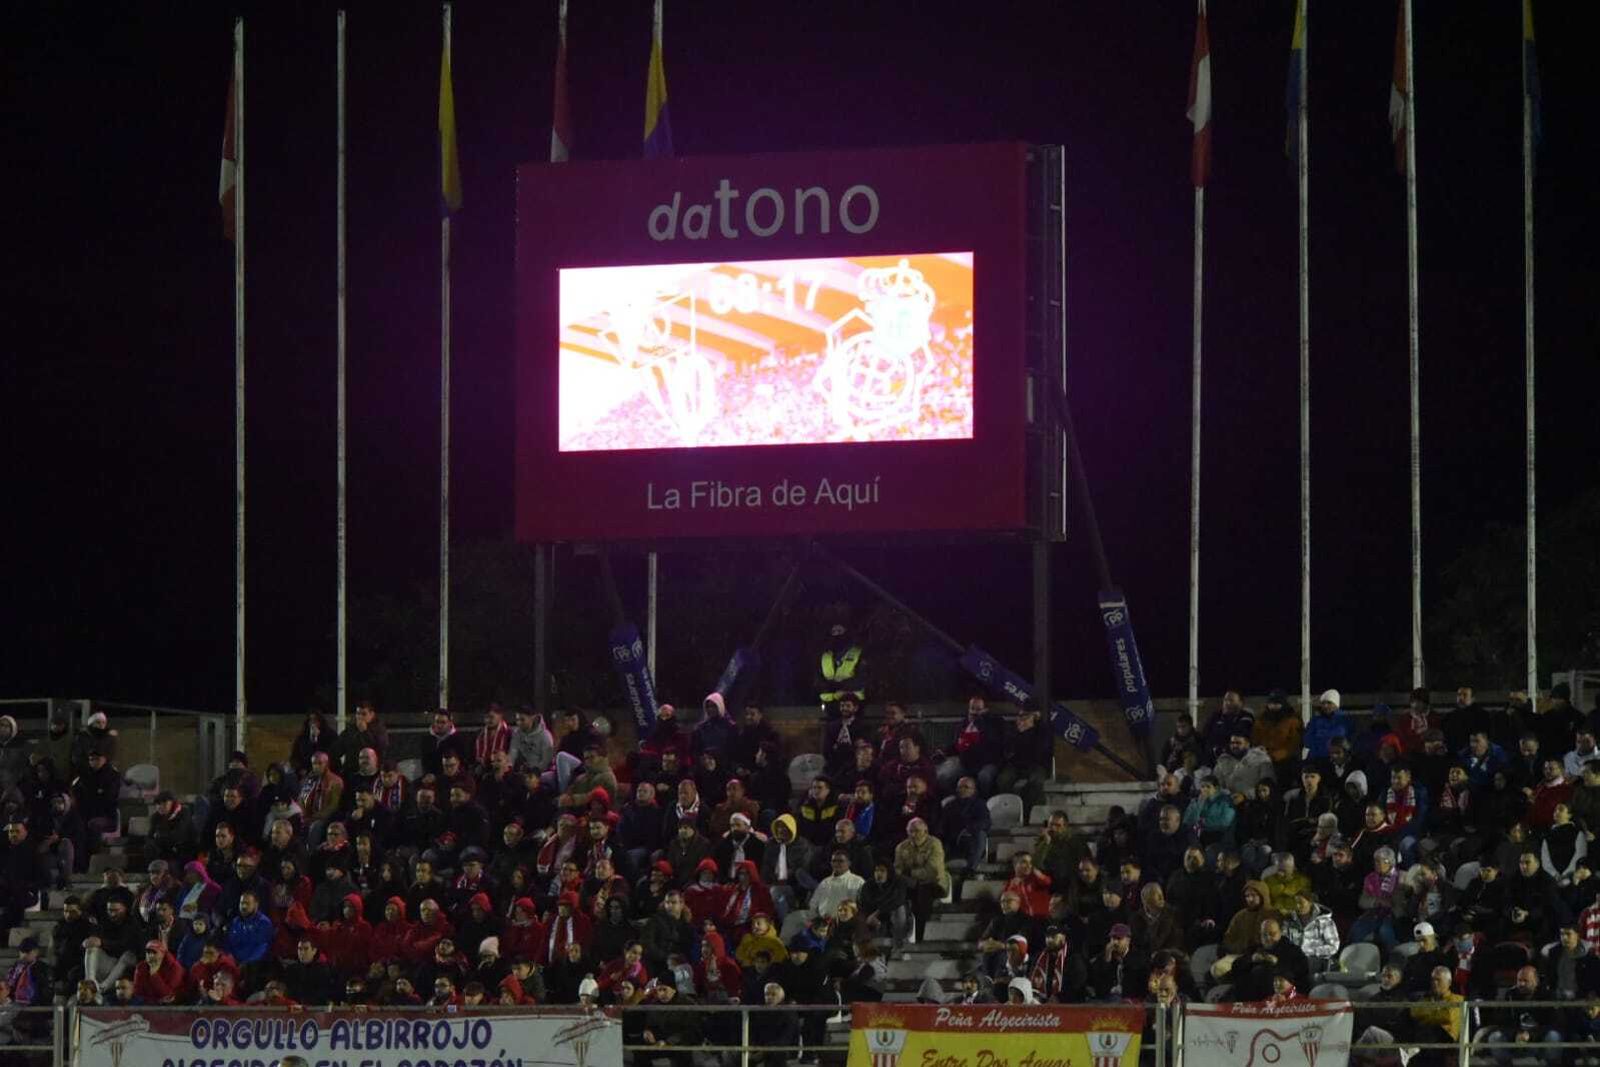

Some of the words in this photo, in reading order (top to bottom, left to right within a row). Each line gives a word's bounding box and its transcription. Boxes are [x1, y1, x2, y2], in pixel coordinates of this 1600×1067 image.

[648, 179, 880, 242] datono
[647, 482, 680, 510] La
[690, 480, 764, 508] Fibra
[771, 478, 807, 507] de
[815, 475, 881, 511] Aquí
[191, 1018, 319, 1050] ORGULLO
[330, 1018, 492, 1050] ALBIRROJO
[934, 1007, 973, 1027] Peña
[978, 1008, 1062, 1032] Algecirista
